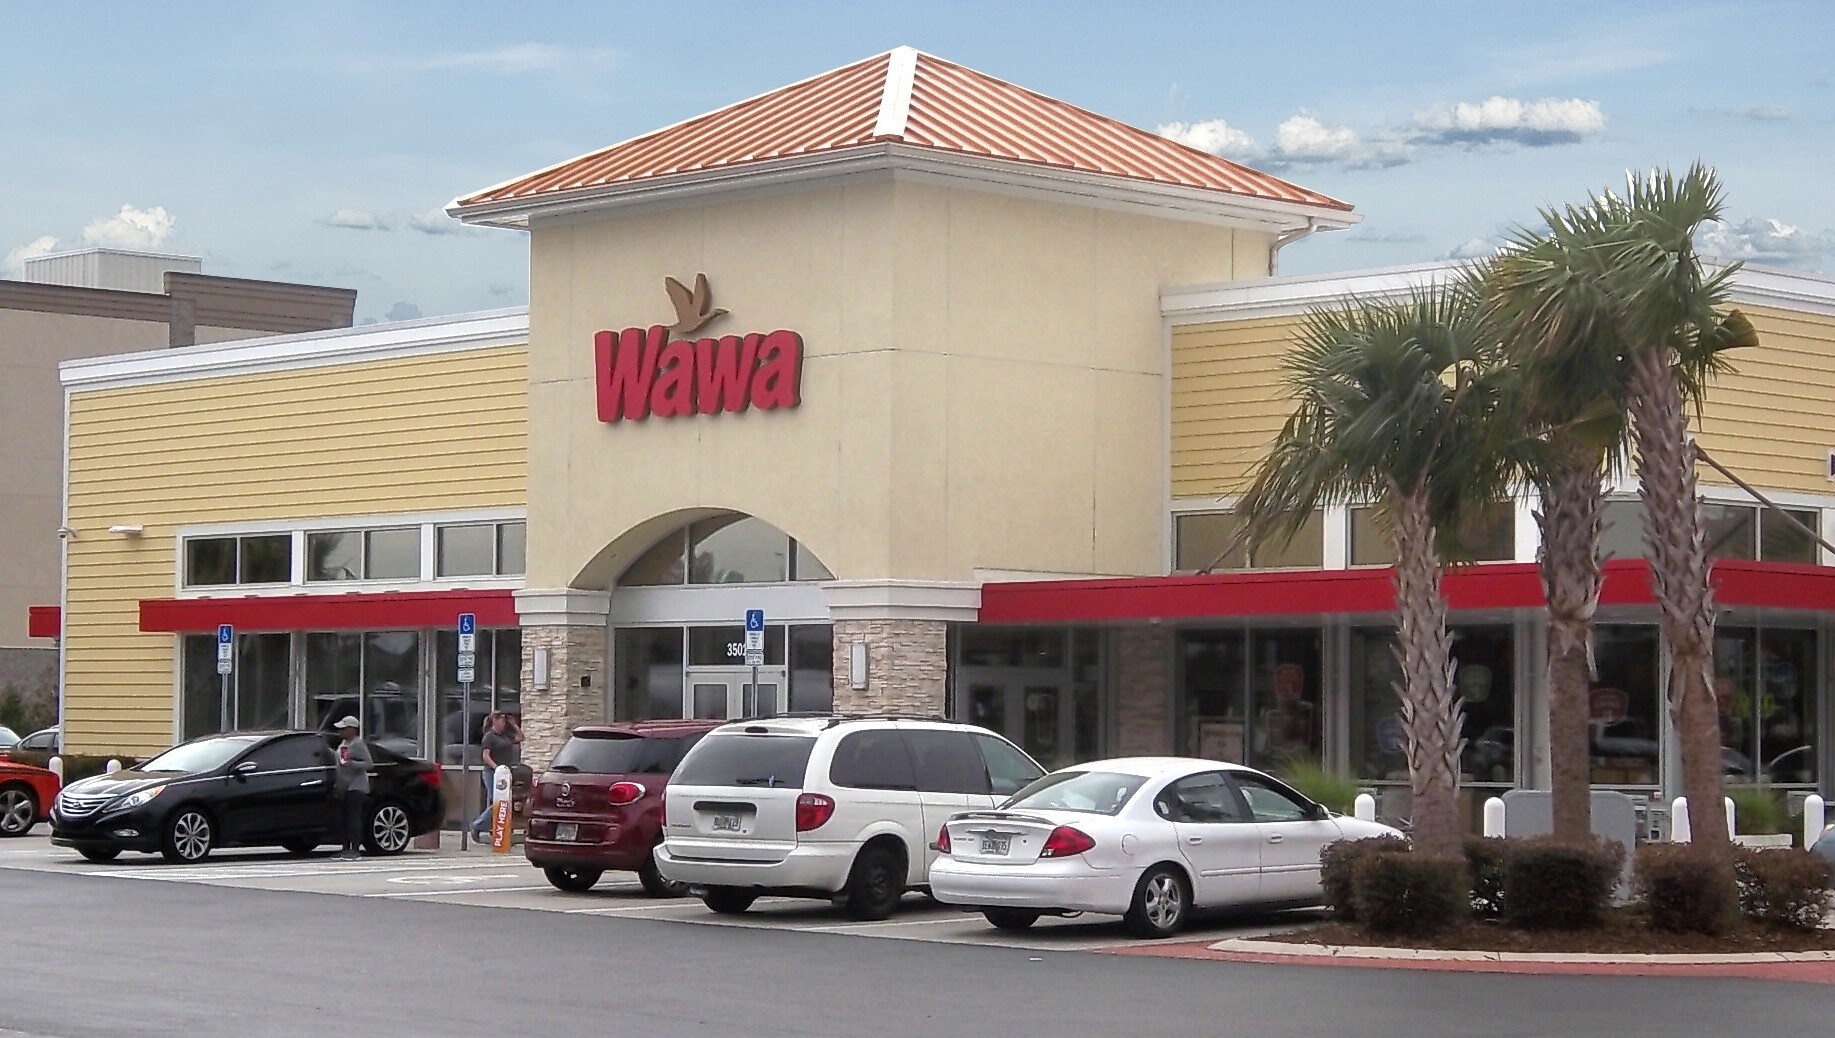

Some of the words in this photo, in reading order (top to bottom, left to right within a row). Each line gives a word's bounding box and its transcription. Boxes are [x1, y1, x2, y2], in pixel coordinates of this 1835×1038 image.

[594, 324, 804, 423] Wawa
[498, 801, 508, 825] HERE
[494, 825, 505, 847] PLAY
